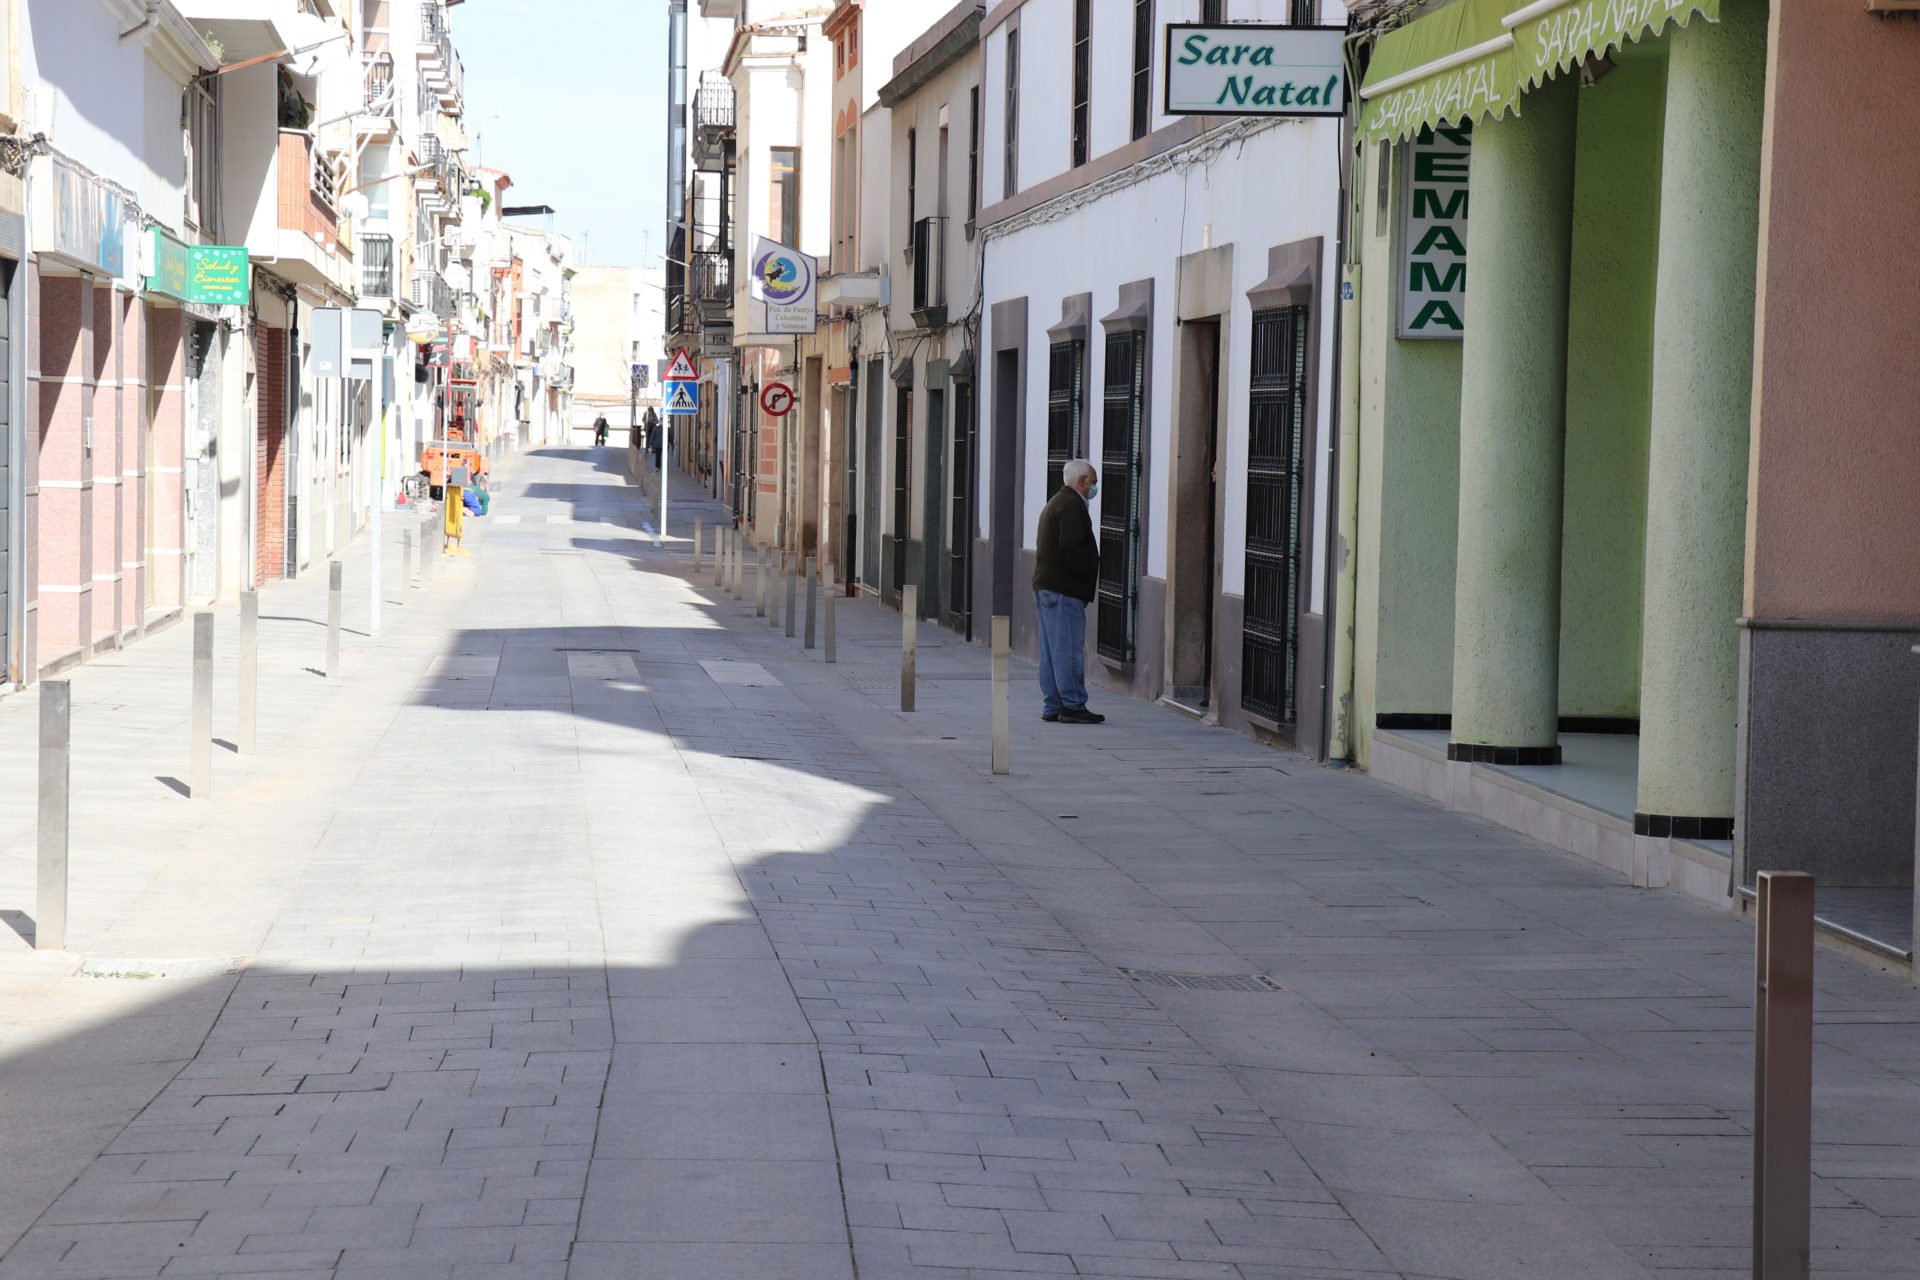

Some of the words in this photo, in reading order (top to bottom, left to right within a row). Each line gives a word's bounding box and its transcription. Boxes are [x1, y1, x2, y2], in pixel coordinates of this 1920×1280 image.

[1177, 34, 1275, 66] Sara
[1216, 74, 1338, 107] Natal
[193, 270, 241, 283] Bienestar
[196, 258, 232, 270] Salud
[230, 266, 240, 274] y
